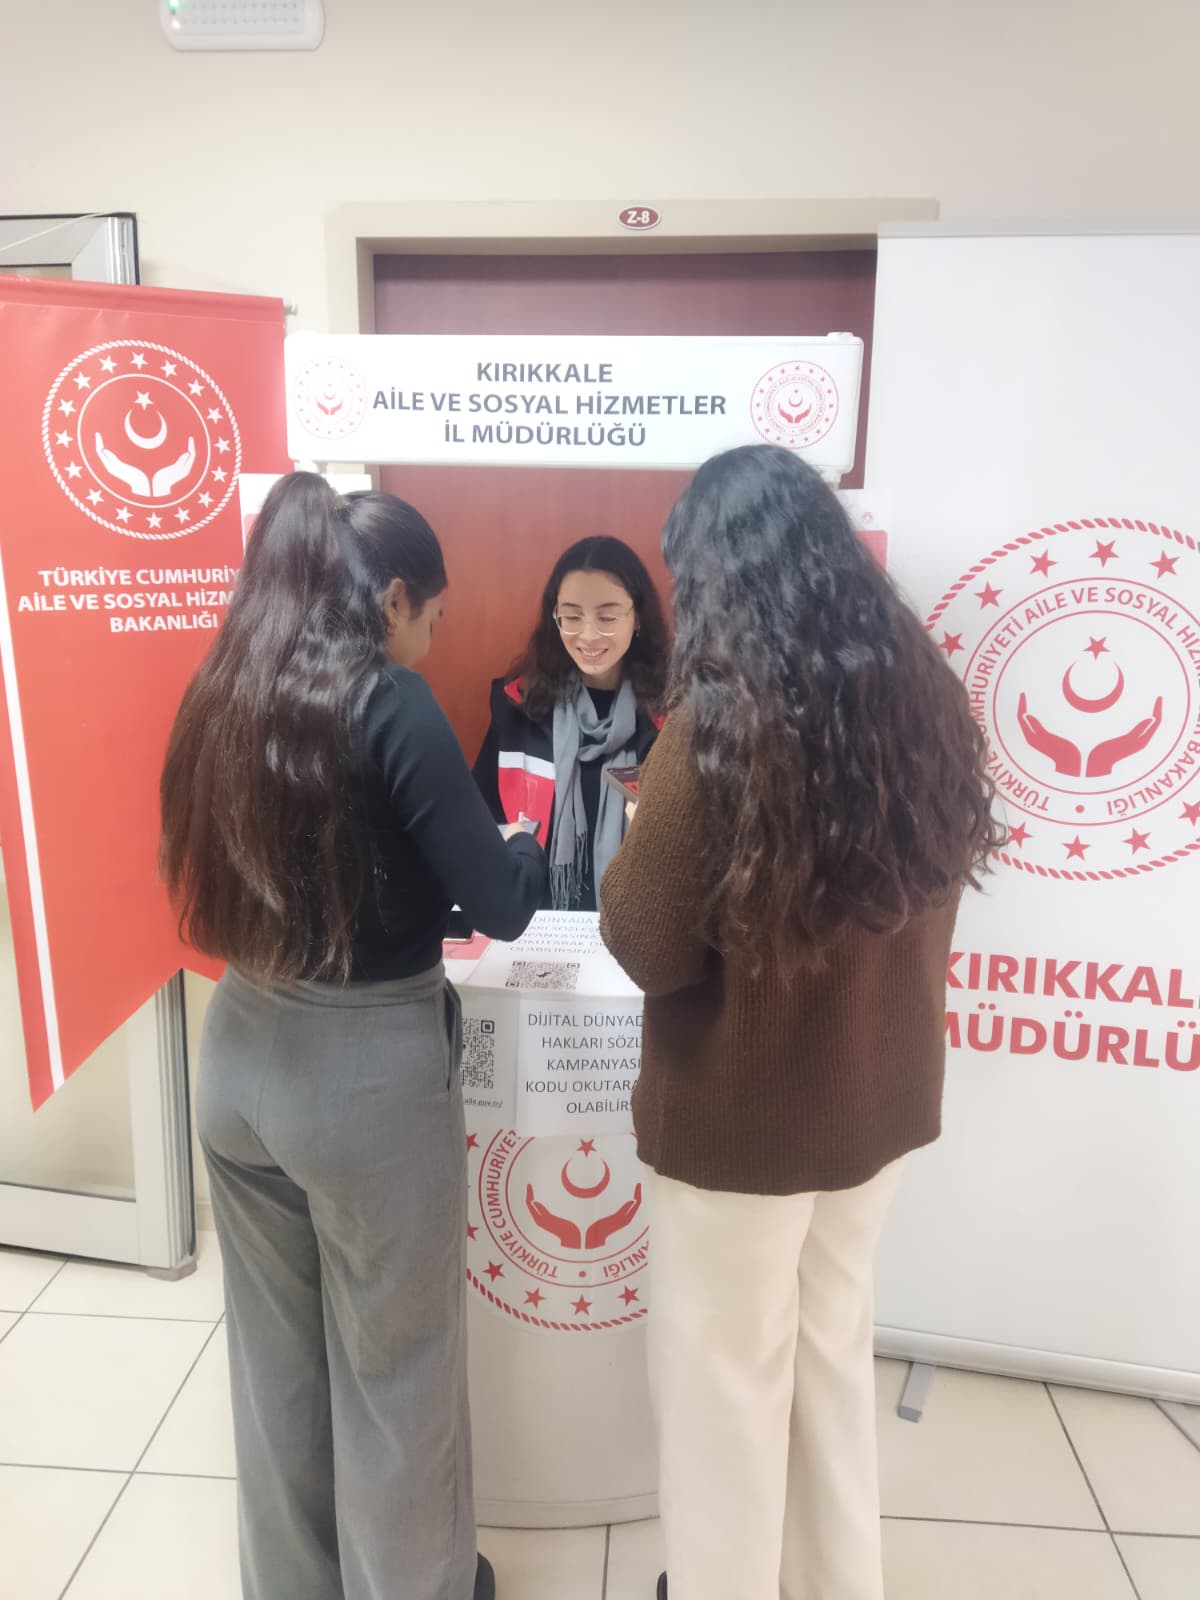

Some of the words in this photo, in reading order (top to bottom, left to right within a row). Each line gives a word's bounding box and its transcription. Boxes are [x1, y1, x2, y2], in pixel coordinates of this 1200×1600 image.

[627, 210, 650, 224] Z-8
[477, 362, 613, 383] KIRIKKALE
[373, 386, 425, 411] AİLE
[430, 393, 461, 412] VE
[468, 393, 568, 415] SOSYAL
[576, 390, 727, 415] HİZMETLER
[445, 419, 465, 443] İL
[472, 420, 646, 447] MÜDÜRLÜĞÜ
[38, 566, 131, 587] TÜRKİYE
[135, 565, 241, 585] CUMHURİY
[17, 592, 67, 612] AİLE
[69, 594, 100, 610] VE
[103, 592, 183, 609] SOSYAL
[186, 588, 234, 607] HİZM
[1071, 586, 1098, 604] VE
[1025, 592, 1068, 624] AİLE
[1104, 587, 1177, 629] SOSYAL
[110, 611, 218, 633] BAKANLIĞI
[1107, 740, 1200, 817] BAKANLIĞI
[946, 952, 1200, 1009] KIRIKKAL
[528, 1011, 579, 1027] DİJİTAL
[584, 1012, 643, 1027] DÜNYAD
[542, 1037, 602, 1049] HAKLARI
[608, 1034, 641, 1049] SÖZL
[945, 1002, 1200, 1072] ÜDÜRLÜ
[547, 1058, 640, 1070] KAMPANYASI
[526, 1080, 568, 1093] KODU
[573, 1080, 638, 1092] OKUTARA
[567, 1099, 632, 1113] OLABİLİR
[500, 1230, 557, 1278] TÜRKİYE
